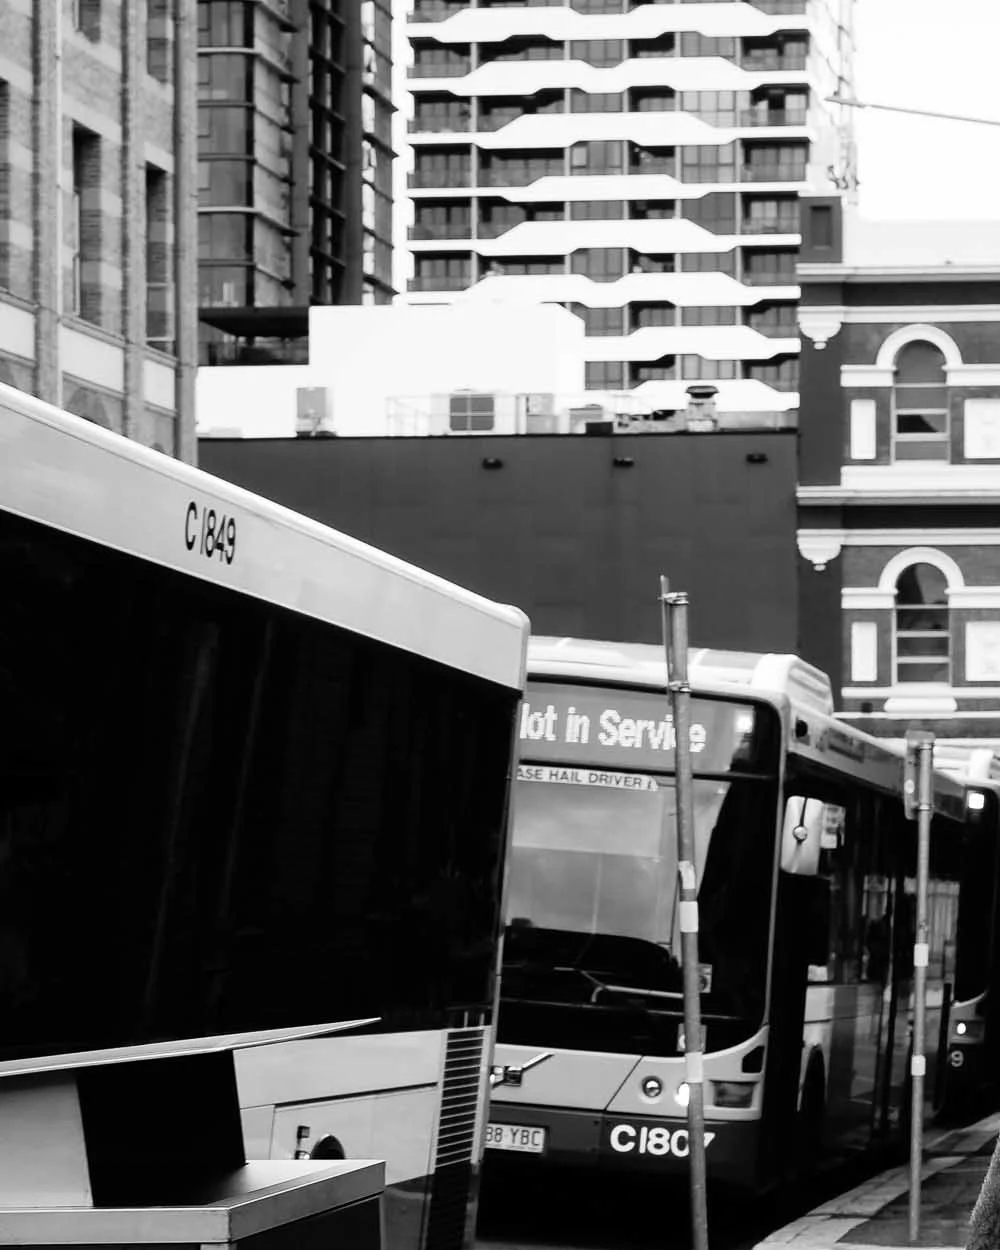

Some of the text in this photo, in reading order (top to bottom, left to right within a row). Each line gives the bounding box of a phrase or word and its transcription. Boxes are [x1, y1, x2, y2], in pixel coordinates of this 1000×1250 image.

[185, 501, 236, 565] C1849
[565, 706, 590, 744] in
[598, 709, 706, 752] Servie
[549, 769, 583, 783] HAIL
[588, 772, 641, 787] DRIVER
